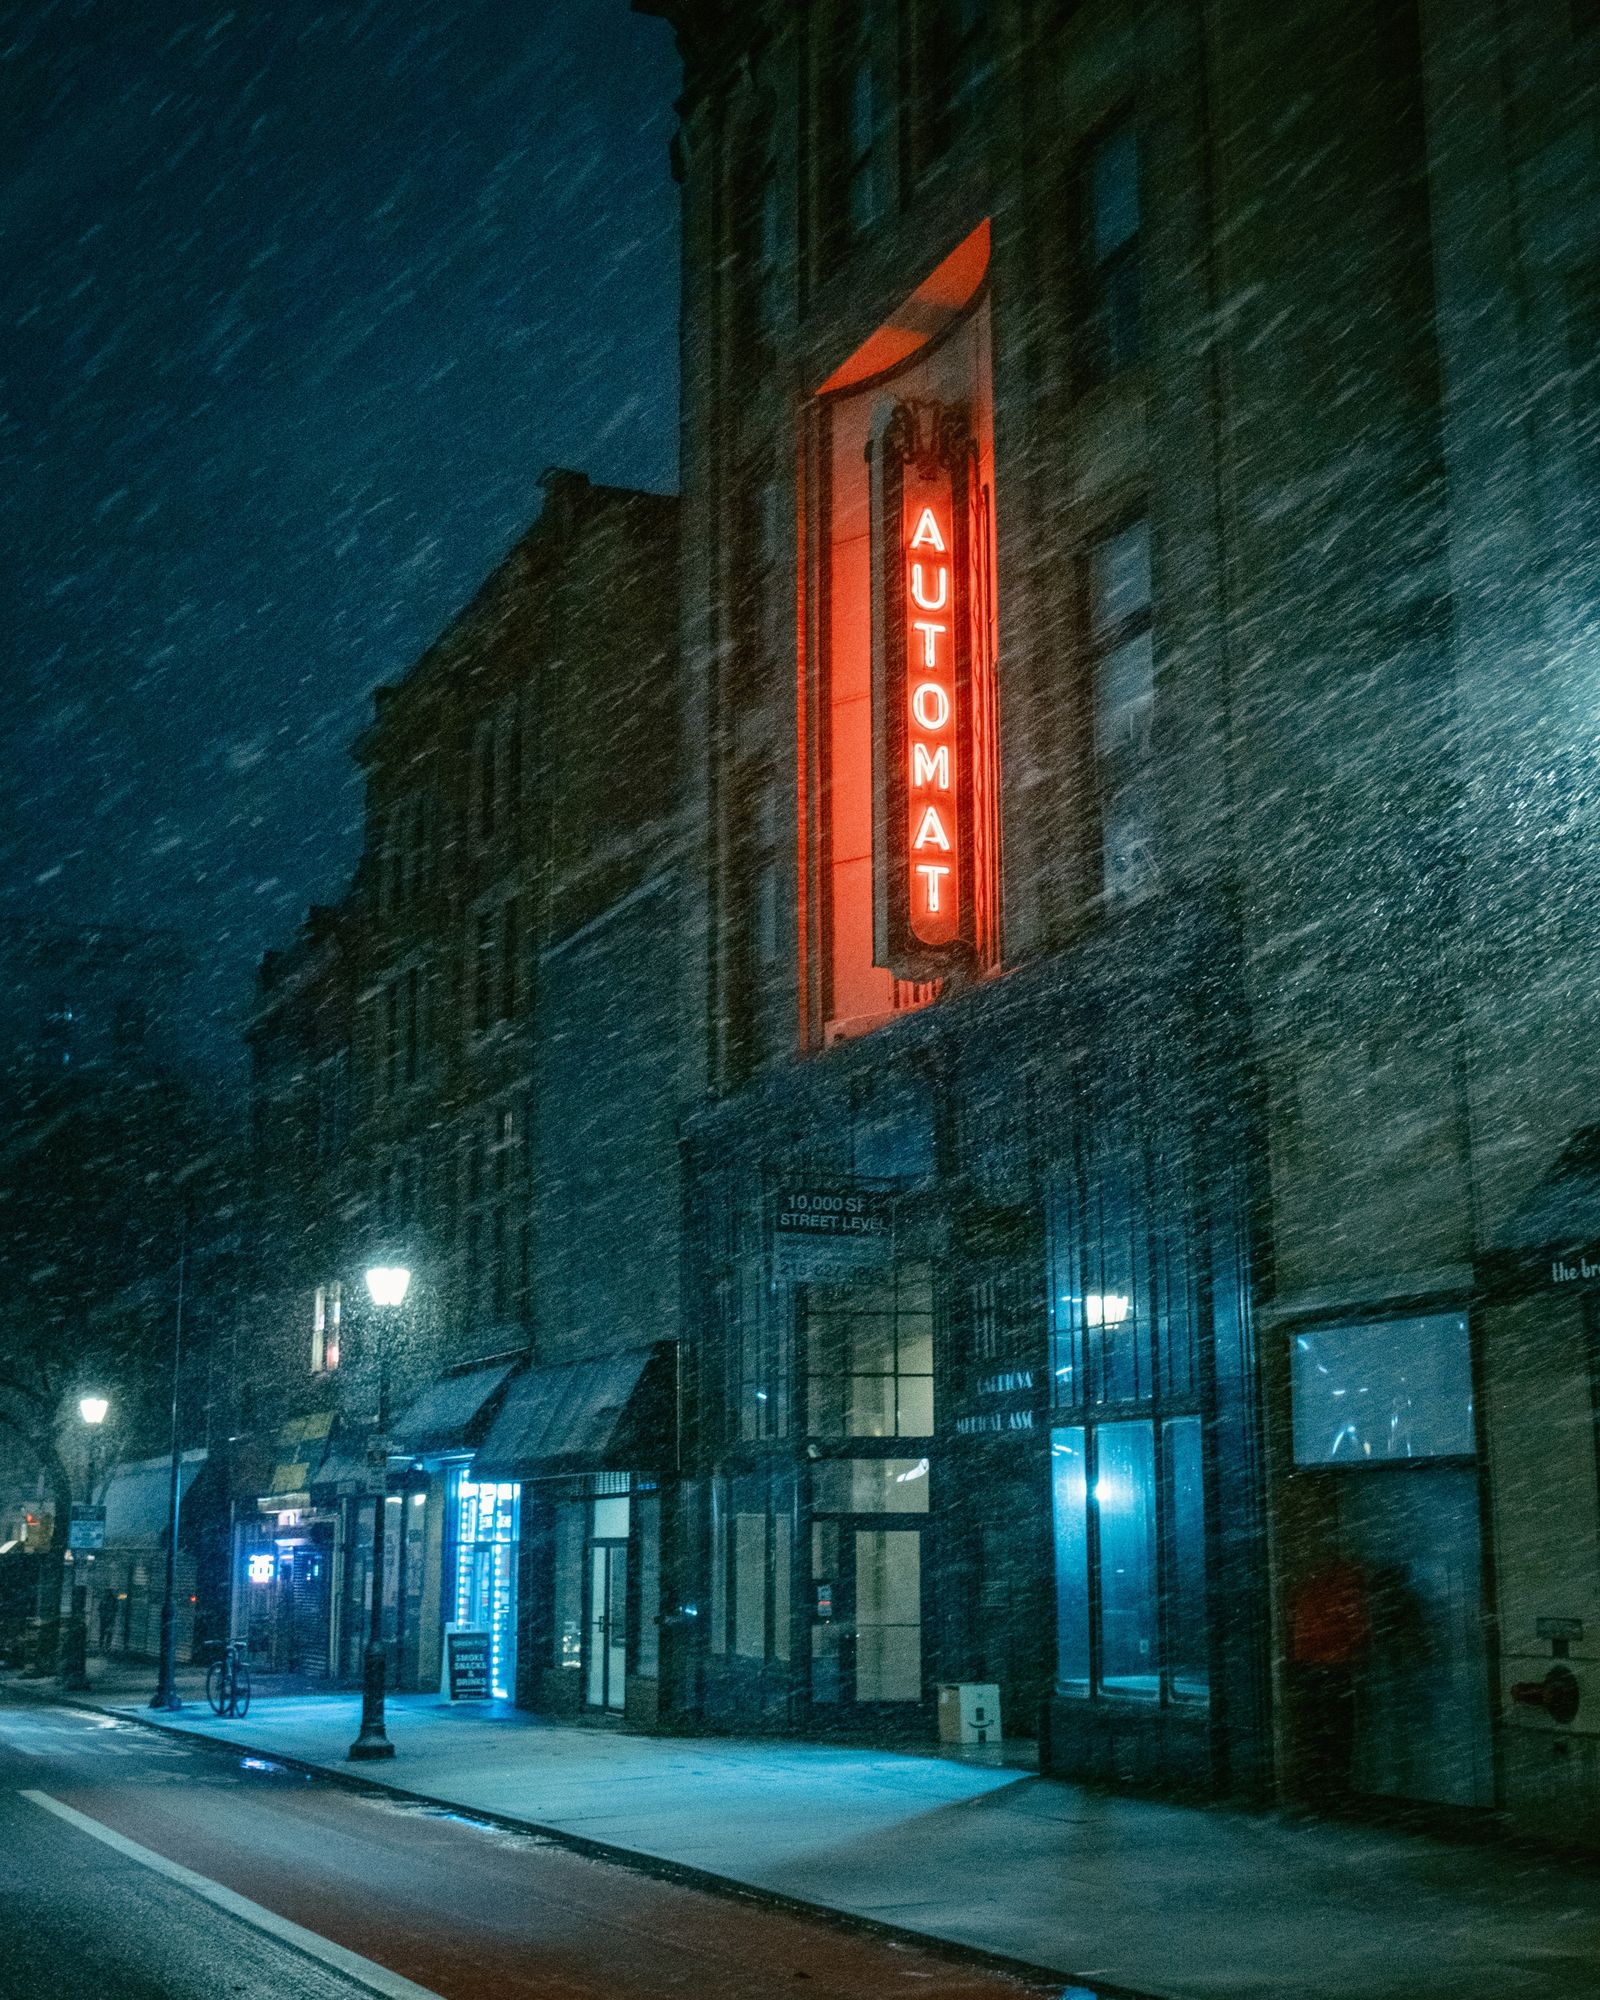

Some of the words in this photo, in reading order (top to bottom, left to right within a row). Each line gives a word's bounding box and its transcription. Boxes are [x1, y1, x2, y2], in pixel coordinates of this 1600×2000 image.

[910, 506, 952, 913] AUTOMAT
[788, 1194, 843, 1212] 10,000
[780, 1213, 840, 1227] STREET
[842, 1216, 887, 1230] LEVEL
[1552, 1261, 1578, 1282] the
[454, 1662, 487, 1670] SNACKS
[456, 1678, 487, 1686] DRINKS
